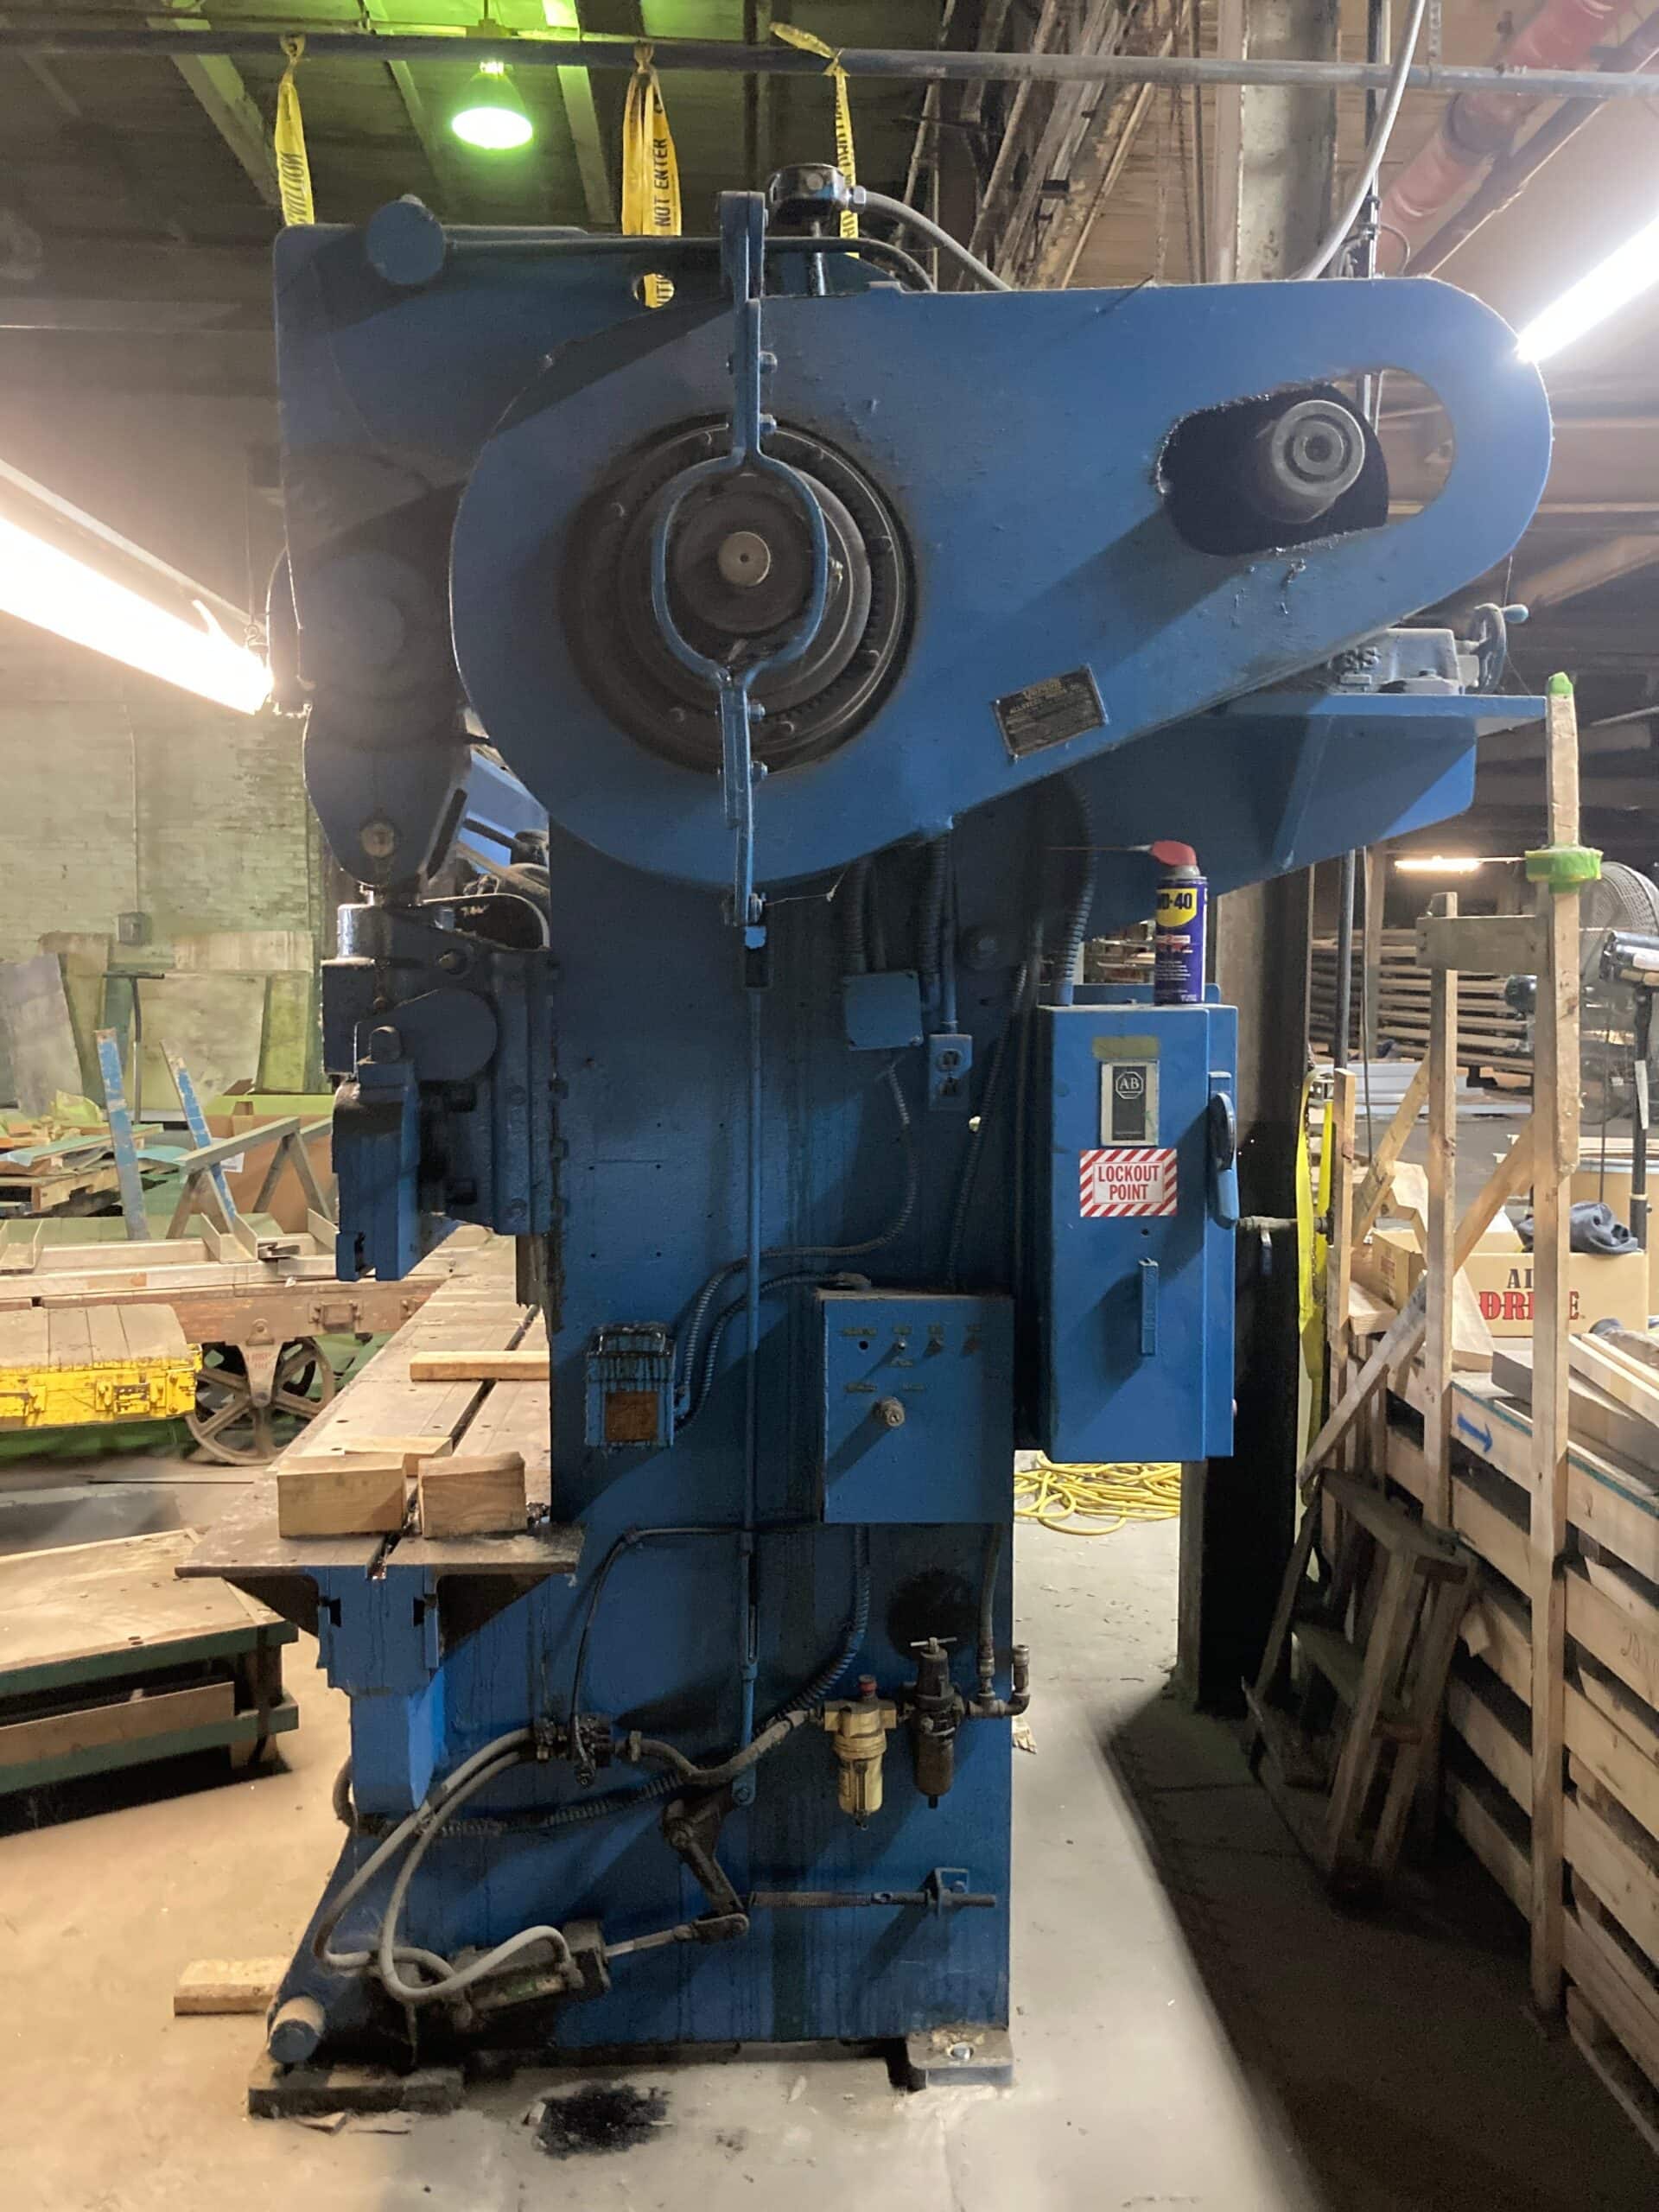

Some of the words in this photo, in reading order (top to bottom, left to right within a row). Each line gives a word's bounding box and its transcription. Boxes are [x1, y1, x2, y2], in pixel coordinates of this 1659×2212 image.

[652, 138, 670, 190] ENTER
[654, 195, 671, 227] NOT
[1120, 1077, 1141, 1090] AB
[1098, 1166, 1160, 1183] LOCKOUT
[1109, 1185, 1148, 1201] POINT
